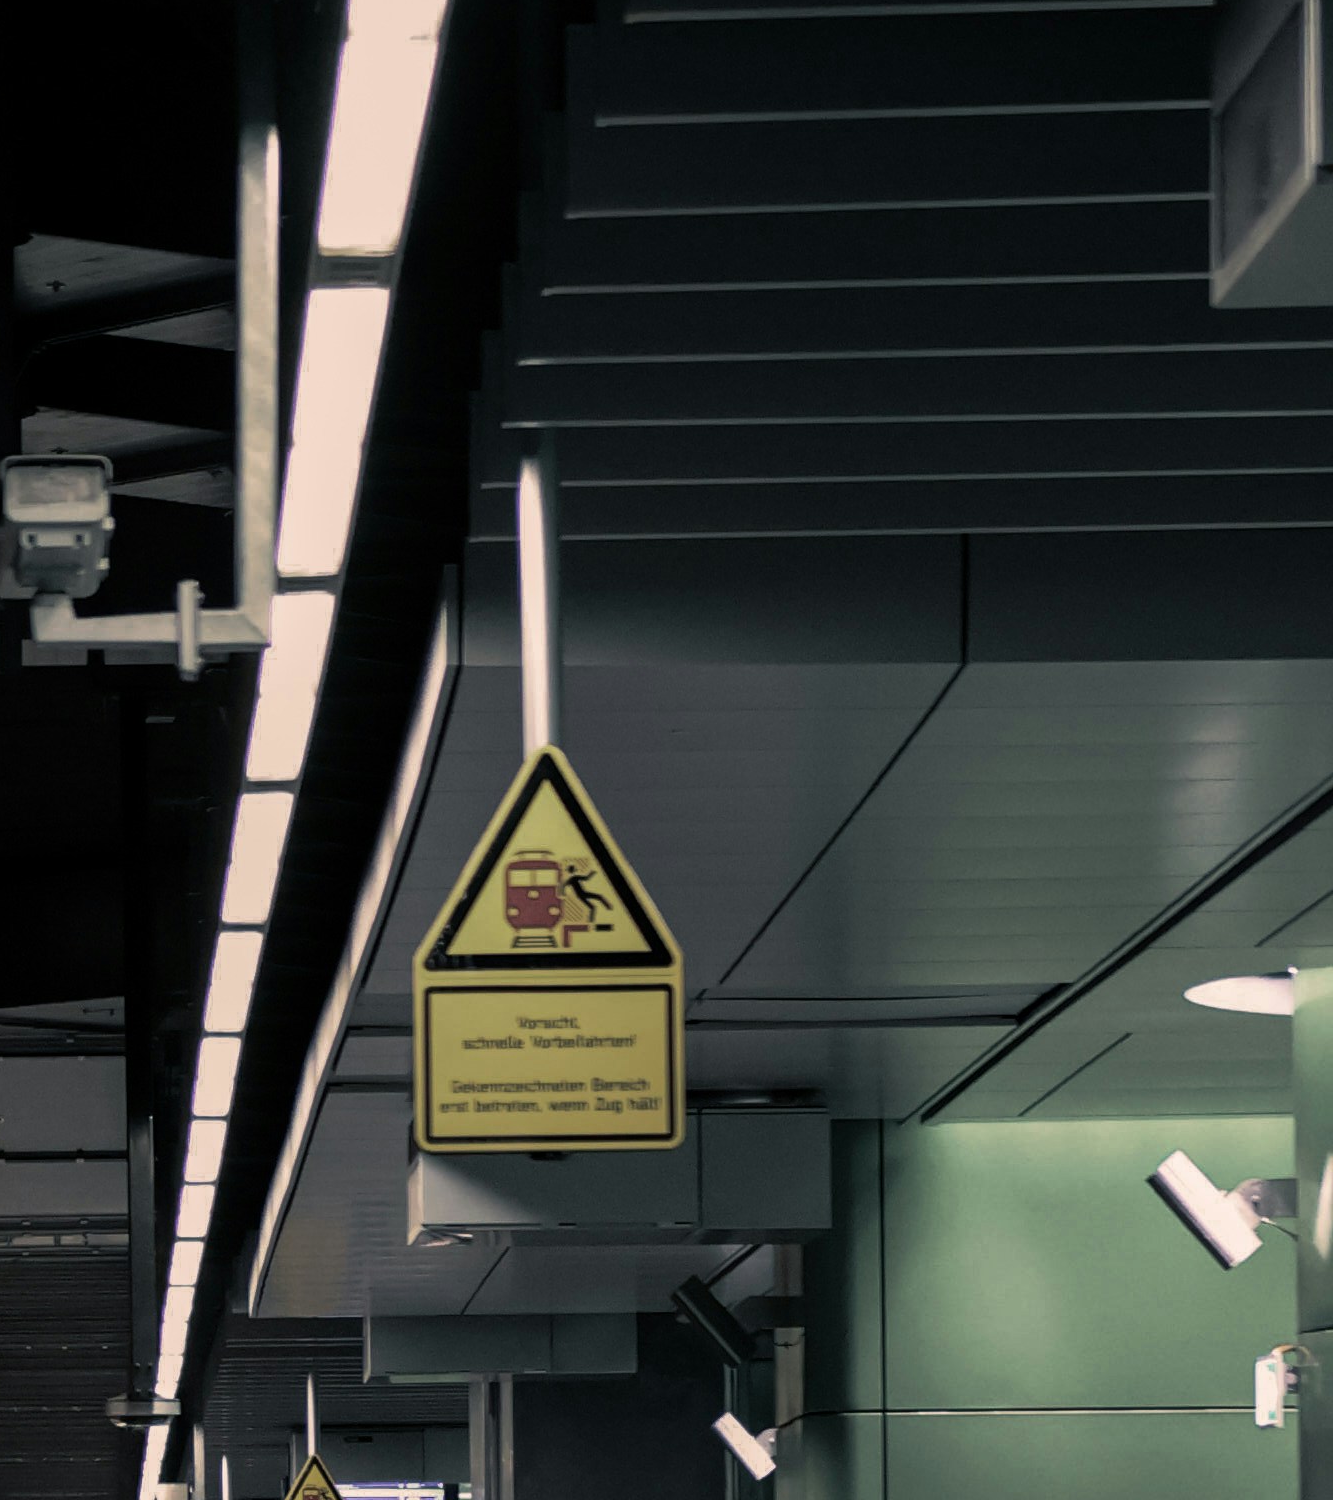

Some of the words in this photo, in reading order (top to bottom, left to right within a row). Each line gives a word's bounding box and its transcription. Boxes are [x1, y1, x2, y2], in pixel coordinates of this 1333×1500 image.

[462, 1035, 525, 1049] schnelle
[591, 1077, 650, 1092] Bereich
[439, 1101, 469, 1113] erst
[547, 1100, 589, 1112] wenn
[594, 1097, 624, 1114] Zug
